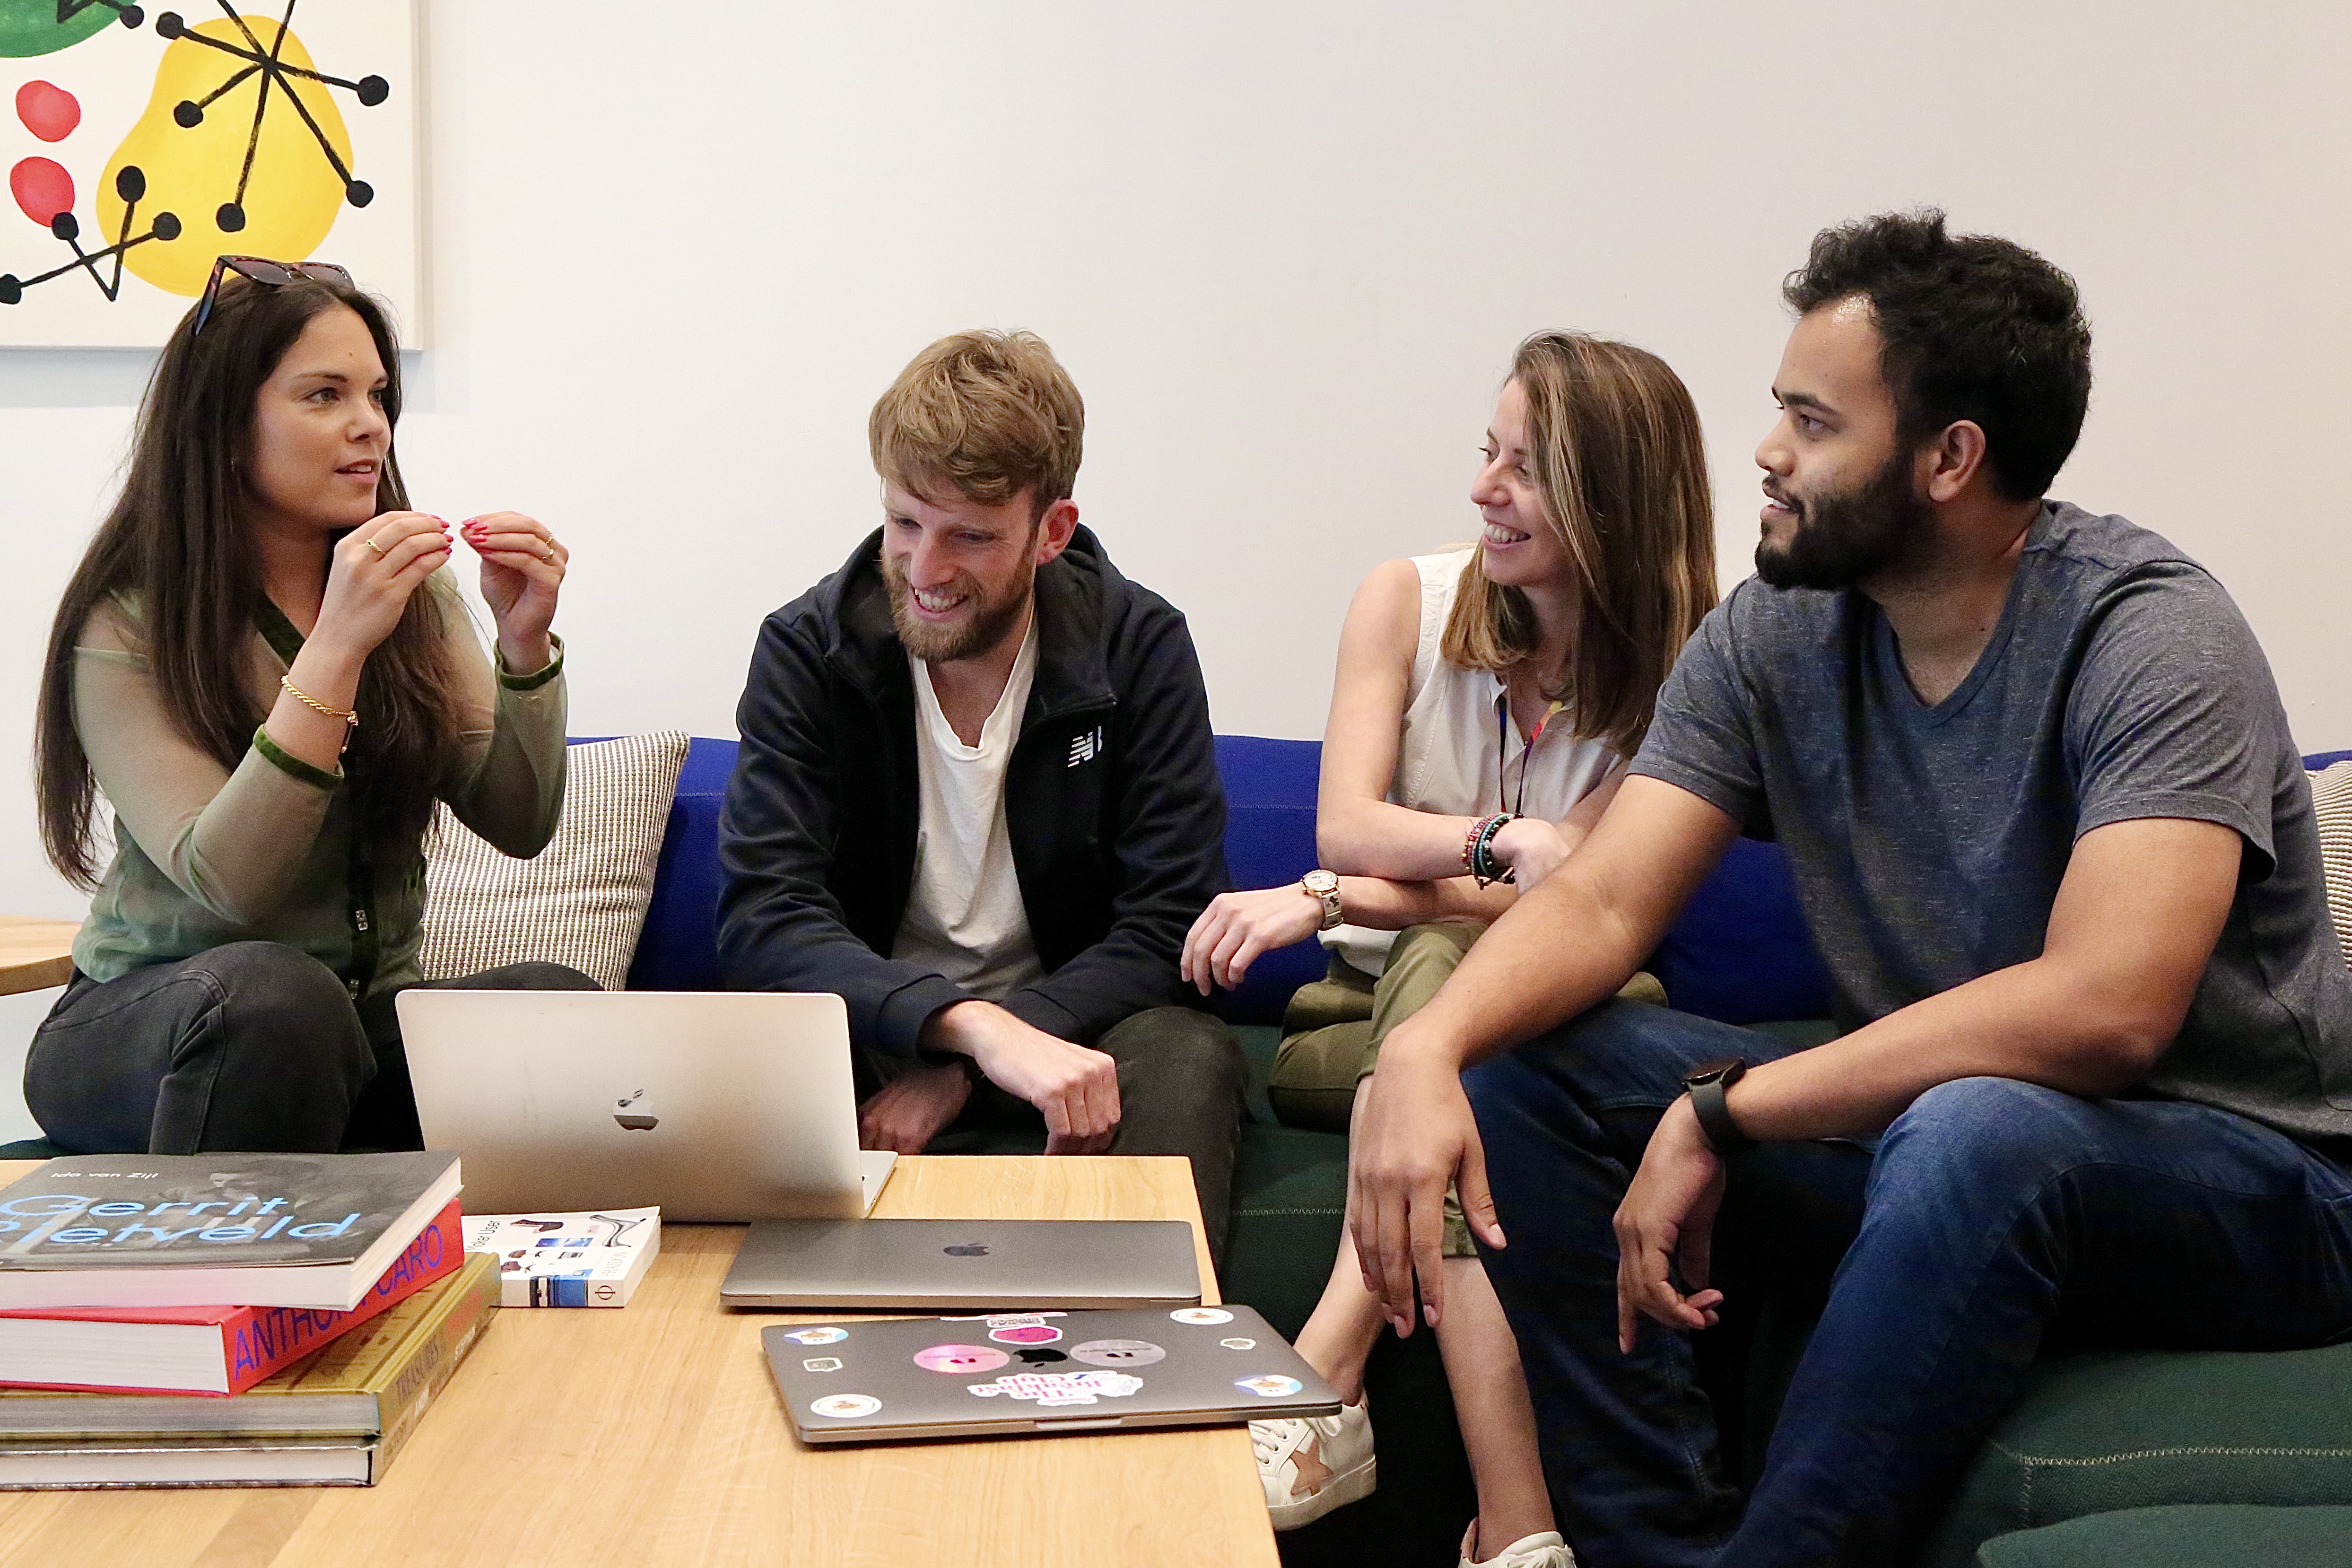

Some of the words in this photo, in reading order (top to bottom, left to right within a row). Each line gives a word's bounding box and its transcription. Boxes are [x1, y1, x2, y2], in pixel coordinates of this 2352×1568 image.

[0, 1193, 289, 1217] Gerrit
[464, 1235, 491, 1251] Maker
[478, 1220, 501, 1235] User
[599, 1252, 627, 1277] PHAIDON
[234, 1297, 366, 1380] ANTH
[1002, 1375, 1065, 1385] Club
